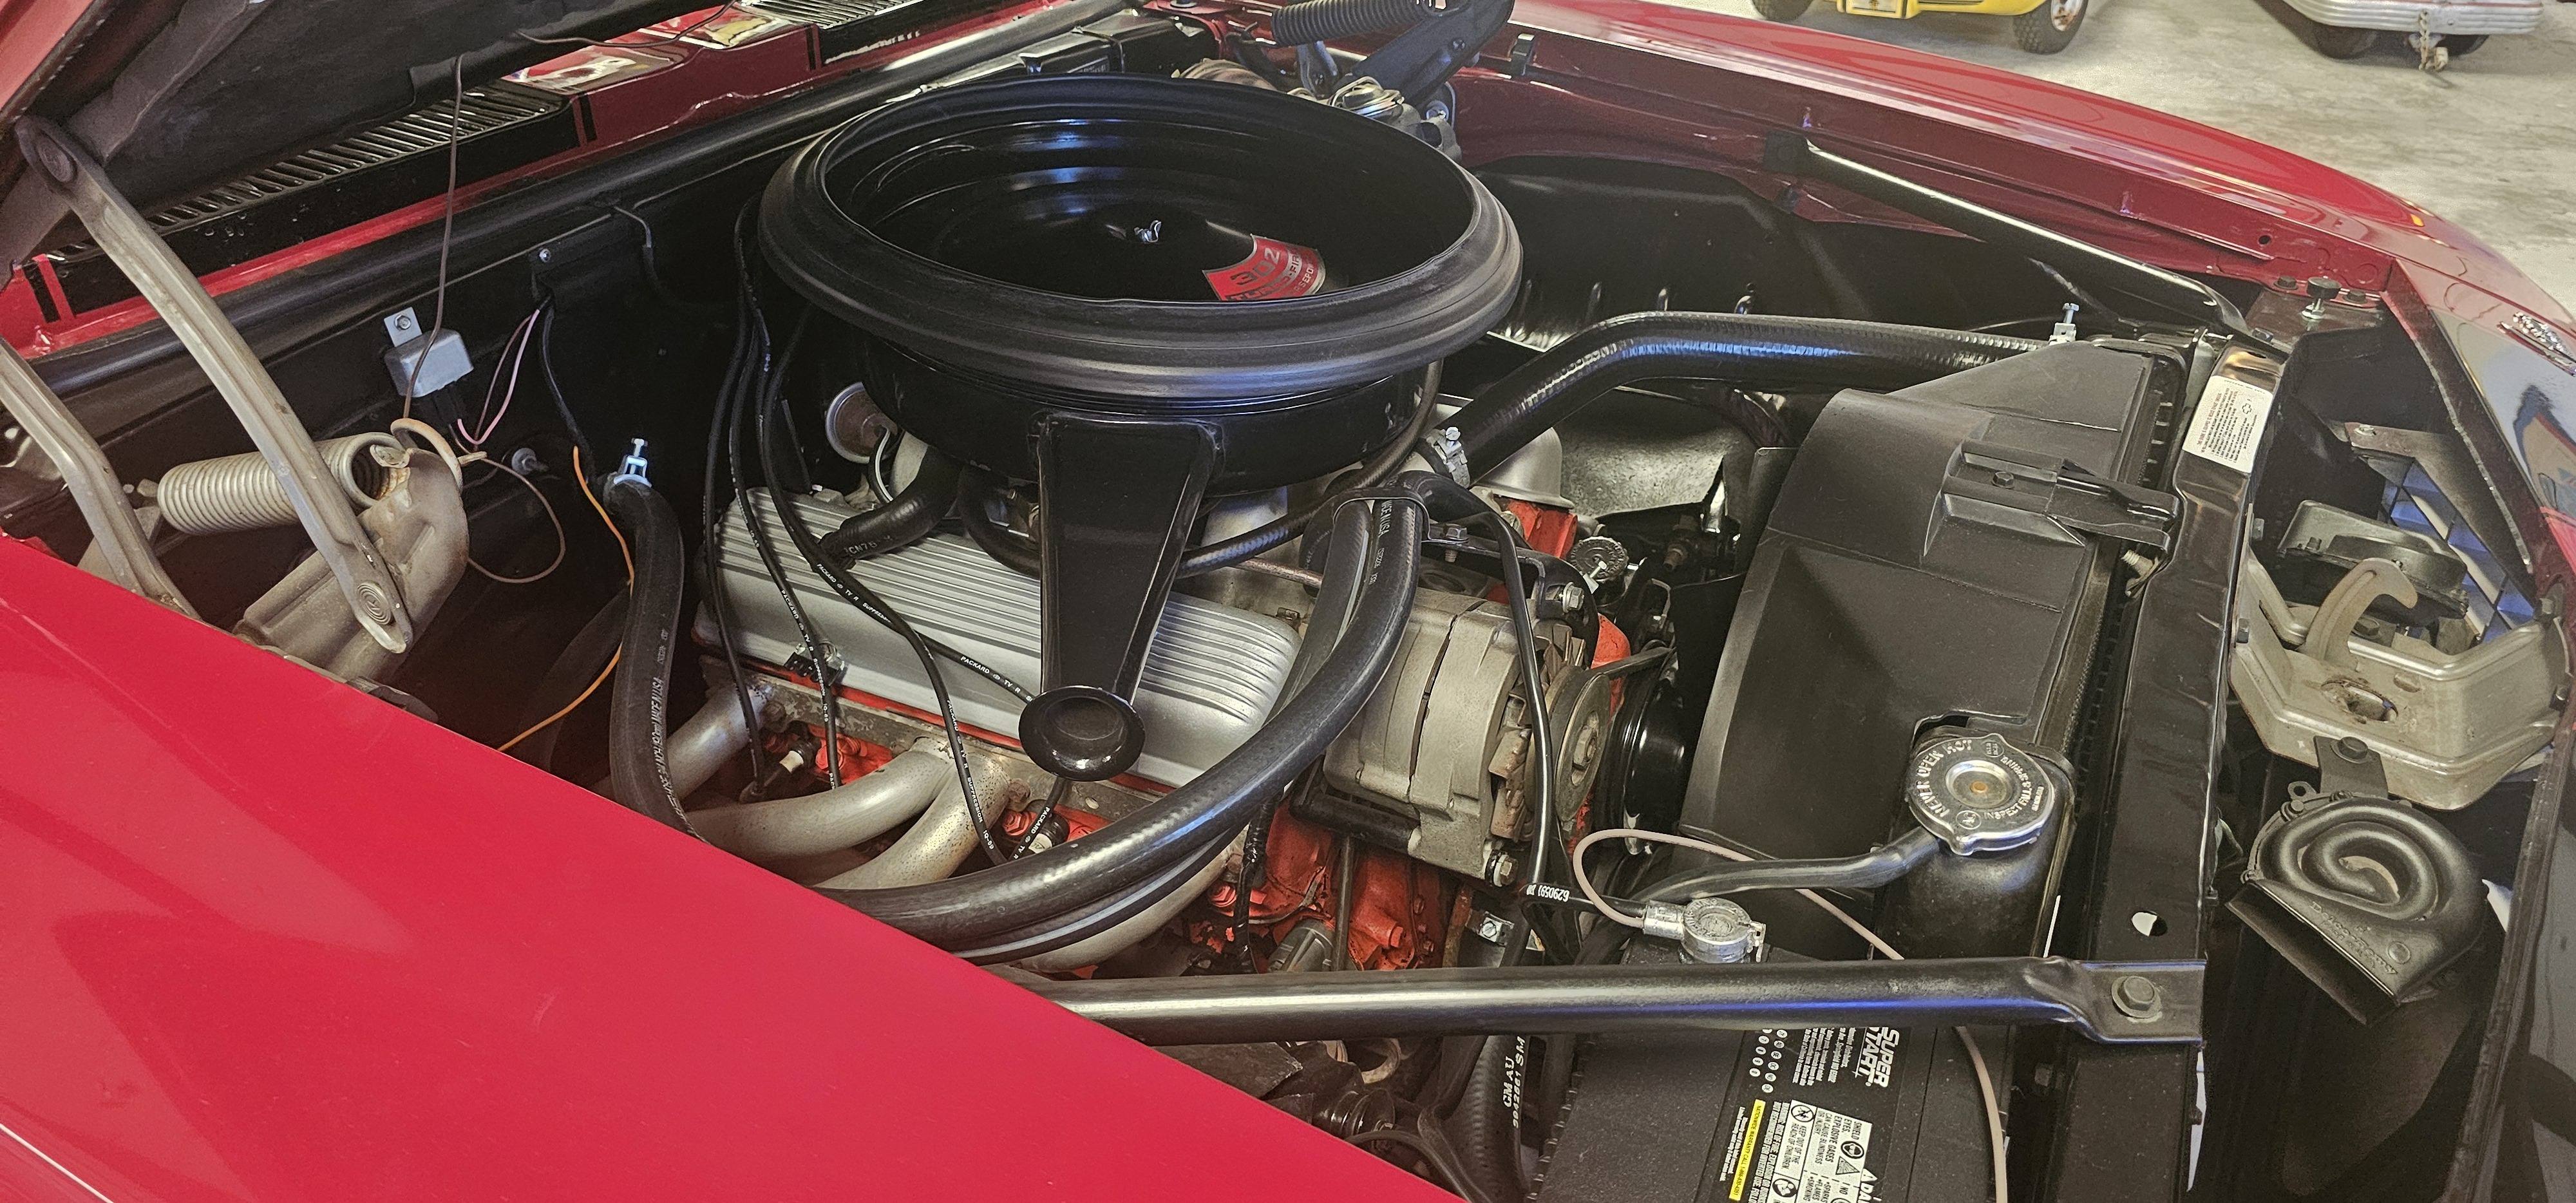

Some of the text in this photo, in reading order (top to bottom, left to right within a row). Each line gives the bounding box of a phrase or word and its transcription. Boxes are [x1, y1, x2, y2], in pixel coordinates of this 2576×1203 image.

[1231, 247, 1280, 285] 302
[817, 564, 836, 582] PACKARD
[779, 588, 799, 618] PACKARD
[804, 634, 810, 642] TV
[961, 656, 989, 674] PACKARD
[1916, 739, 1972, 817] NEVER OPEN HOT
[965, 777, 983, 822] SUPPRESSION
[1030, 806, 1050, 834] PACKARD
[1984, 802, 2022, 820] INSPECT
[1018, 845, 1025, 853] TV
[1538, 885, 1569, 902] 6290591
[1513, 1036, 1525, 1066] SM
[1873, 1027, 1899, 1087] SUPER
[1750, 1104, 1762, 1130] NATIONWIDE
[1841, 1117, 1852, 1134] EYES.
[1788, 1122, 1799, 1138] REACH
[1797, 1124, 1807, 1137] KEEP
[1824, 1115, 1842, 1163] EXPLOSIVE GASES
[1850, 1121, 1863, 1141] SHIELD
[1743, 1130, 1755, 1154] WARRANTY
[1795, 1137, 1804, 1147] OUT
[1814, 1137, 1827, 1165] BLINDNESS
[1741, 1153, 1749, 1166] CALL
[1780, 1145, 1794, 1171] CHILDREN.
[1791, 1155, 1800, 1164] THE
[1802, 1178, 1815, 1202] SMOKING
[1811, 1180, 1823, 1201] FLAMES
[1838, 1186, 1848, 1195] NO
